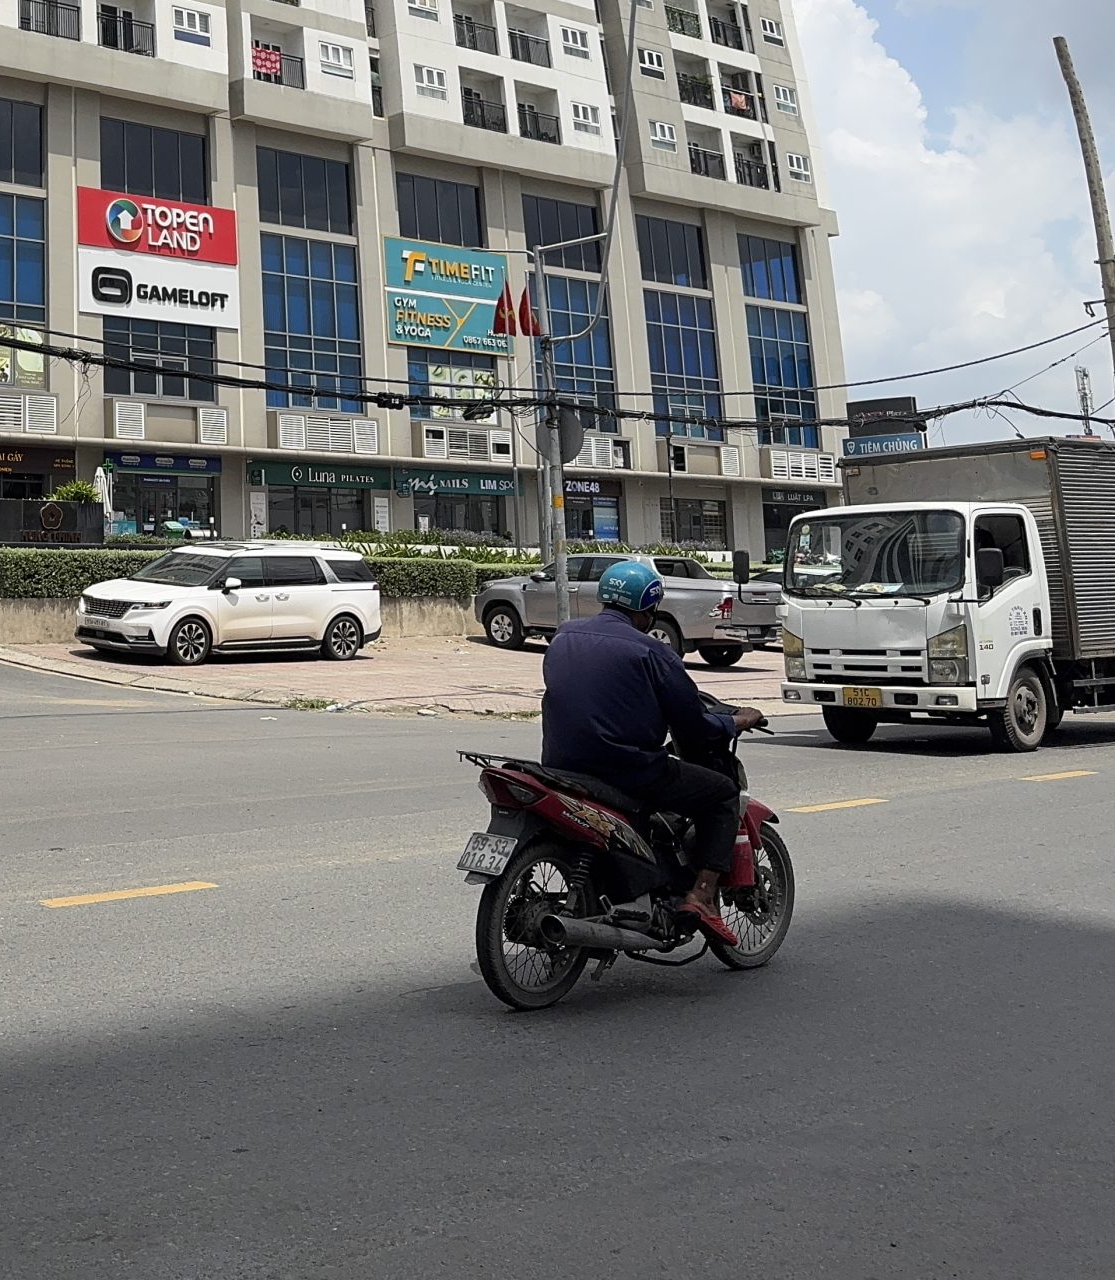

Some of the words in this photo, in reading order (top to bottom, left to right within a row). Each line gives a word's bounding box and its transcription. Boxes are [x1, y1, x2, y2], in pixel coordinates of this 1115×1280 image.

[148, 227, 201, 251] LAND
[136, 284, 229, 308] GAMELOFT
[394, 297, 417, 308] GYM
[396, 310, 451, 328] FITNESS
[497, 340, 508, 348] 06
[859, 439, 881, 454] TIÊM
[882, 437, 918, 452] CHỦNG
[7, 451, 24, 462] GÁY
[308, 467, 335, 483] Luna
[341, 474, 374, 483] PILATES
[440, 478, 469, 489] NAILS
[480, 479, 497, 490] LIM
[566, 481, 600, 493] ZONE48
[853, 688, 869, 697] 51C
[847, 697, 877, 707] 802.70
[472, 835, 509, 855] 59-S3
